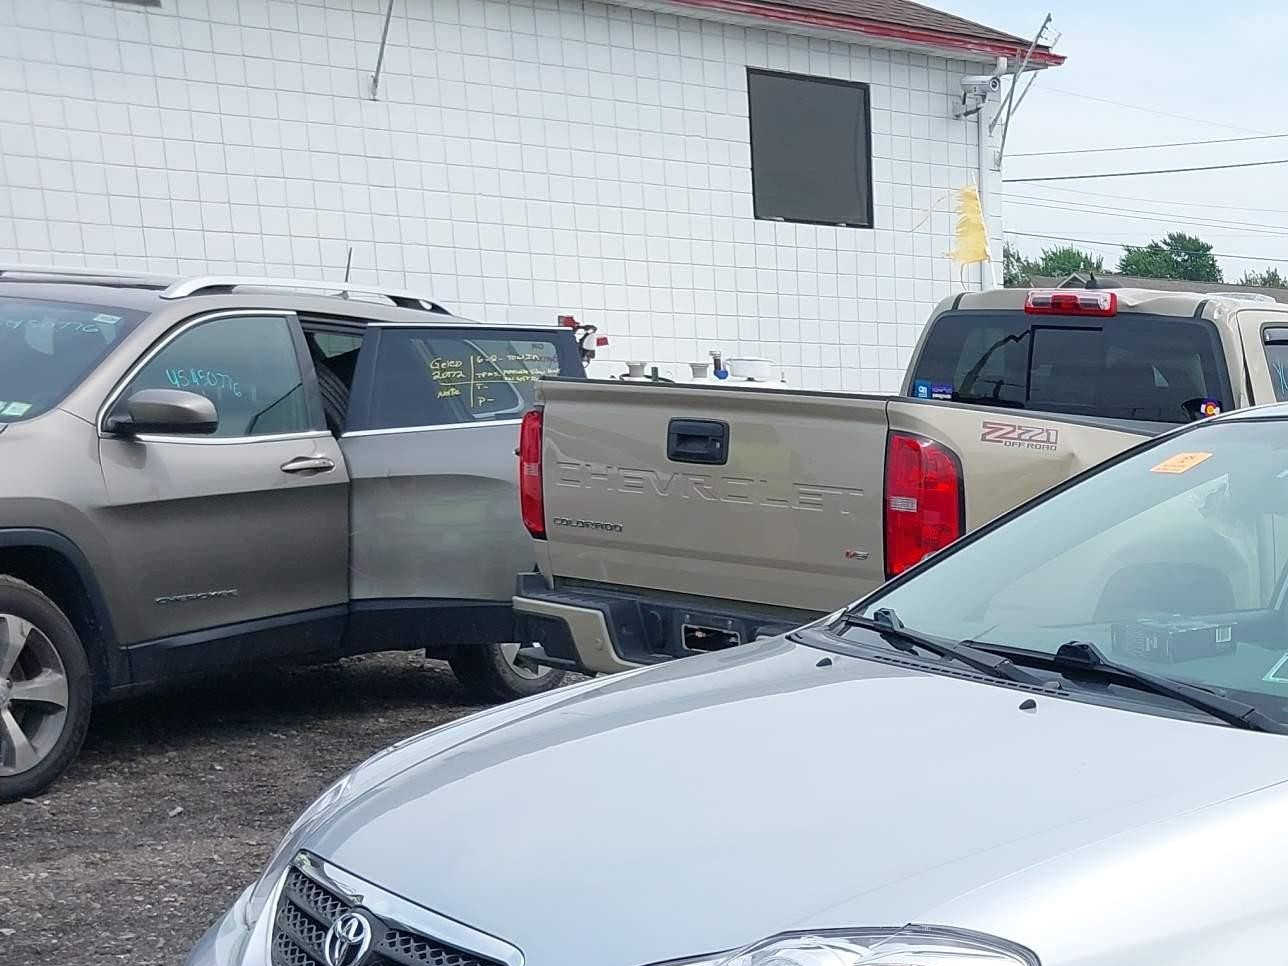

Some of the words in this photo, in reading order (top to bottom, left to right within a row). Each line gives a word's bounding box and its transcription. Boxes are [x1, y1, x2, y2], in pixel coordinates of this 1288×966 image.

[981, 421, 1059, 445] Z71
[1004, 441, 1026, 449] OFF
[1026, 442, 1058, 451] ROAD
[556, 461, 865, 515] CHEVROLET
[553, 517, 624, 533] COLORADO
